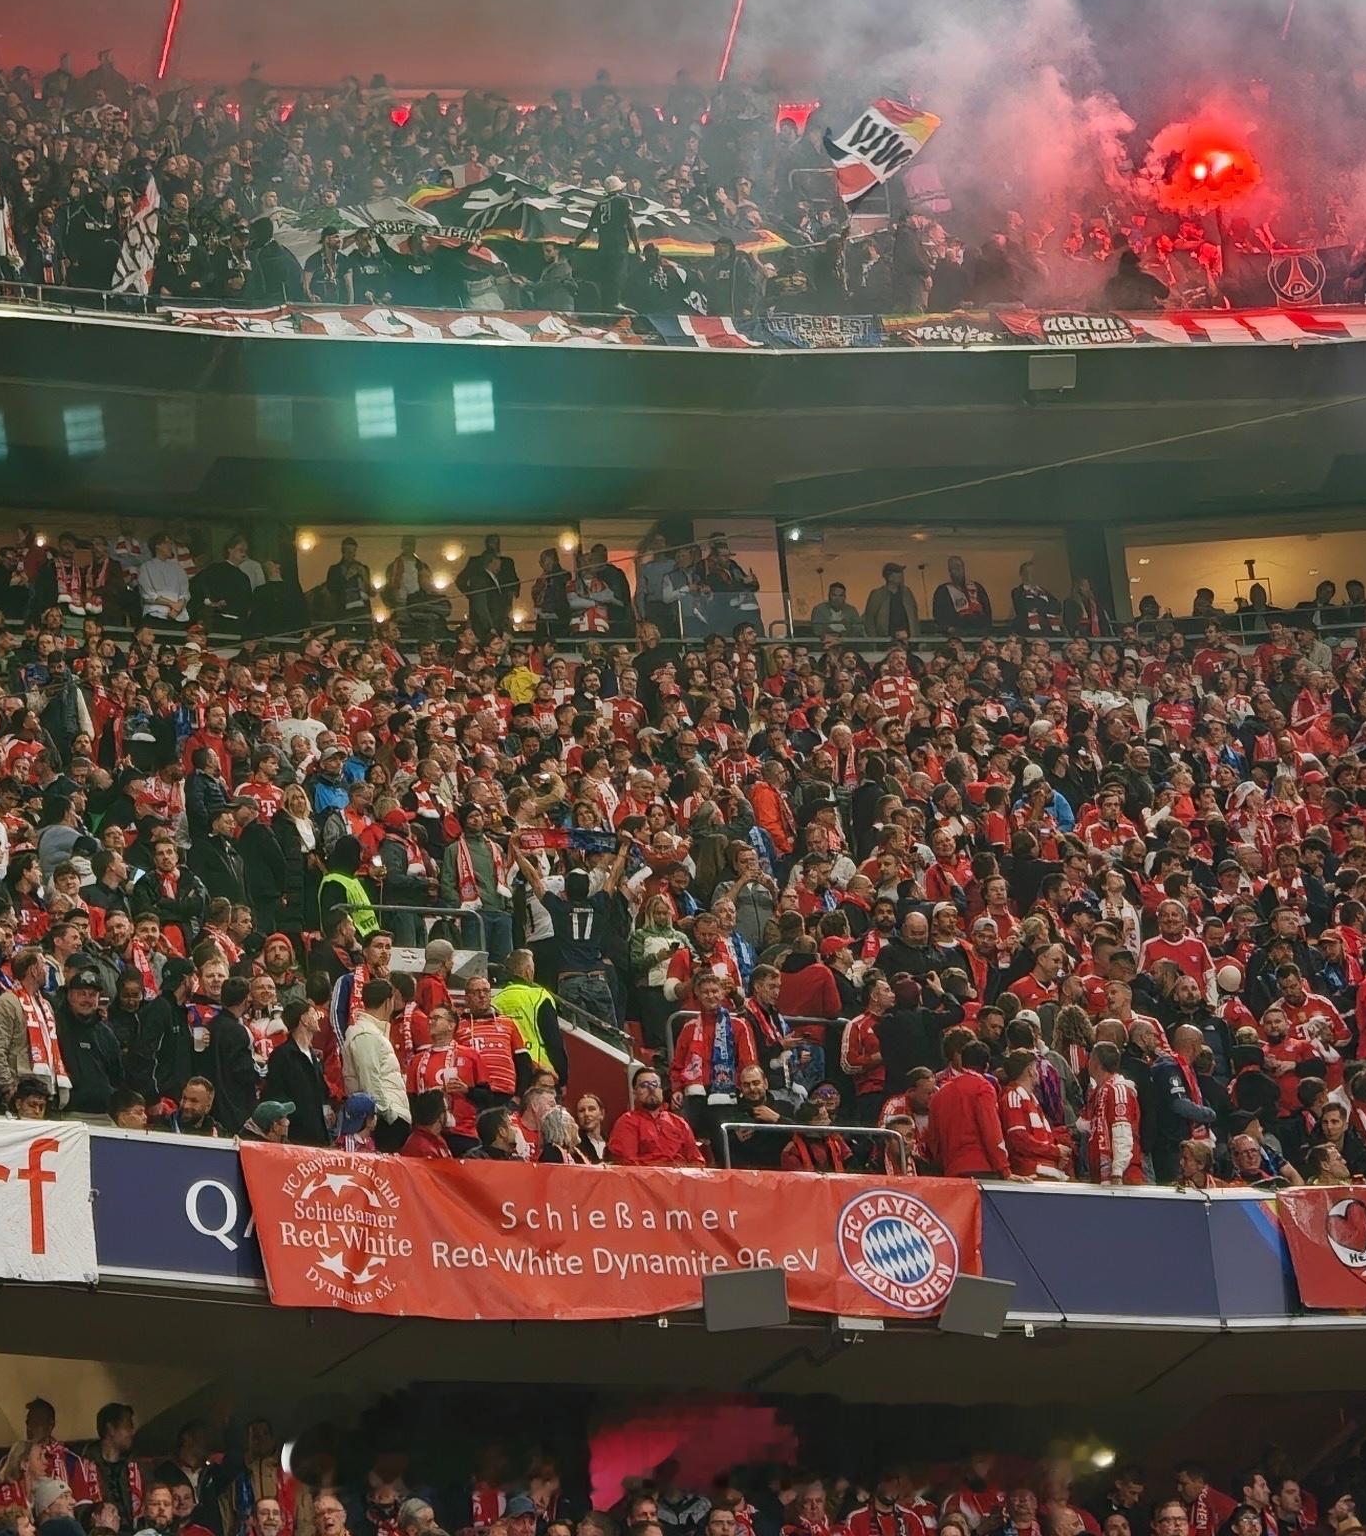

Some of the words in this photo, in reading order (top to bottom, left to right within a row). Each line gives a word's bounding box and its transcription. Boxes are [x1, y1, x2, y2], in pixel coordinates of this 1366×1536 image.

[282, 1173, 301, 1199] FC
[299, 1155, 346, 1180] Bayern
[350, 1156, 401, 1209] Fanclub
[186, 1180, 255, 1252] Q
[294, 1200, 397, 1229] Schießamer
[501, 1201, 740, 1232] Schießamer
[844, 1215, 863, 1243] FC
[859, 1197, 949, 1246] BAYERN
[280, 1221, 413, 1257] Red-White
[432, 1240, 583, 1276] Red-White
[592, 1246, 730, 1281] Dynamite
[736, 1247, 775, 1270] 96
[782, 1247, 819, 1273] eV
[305, 1266, 373, 1306] Dynamite
